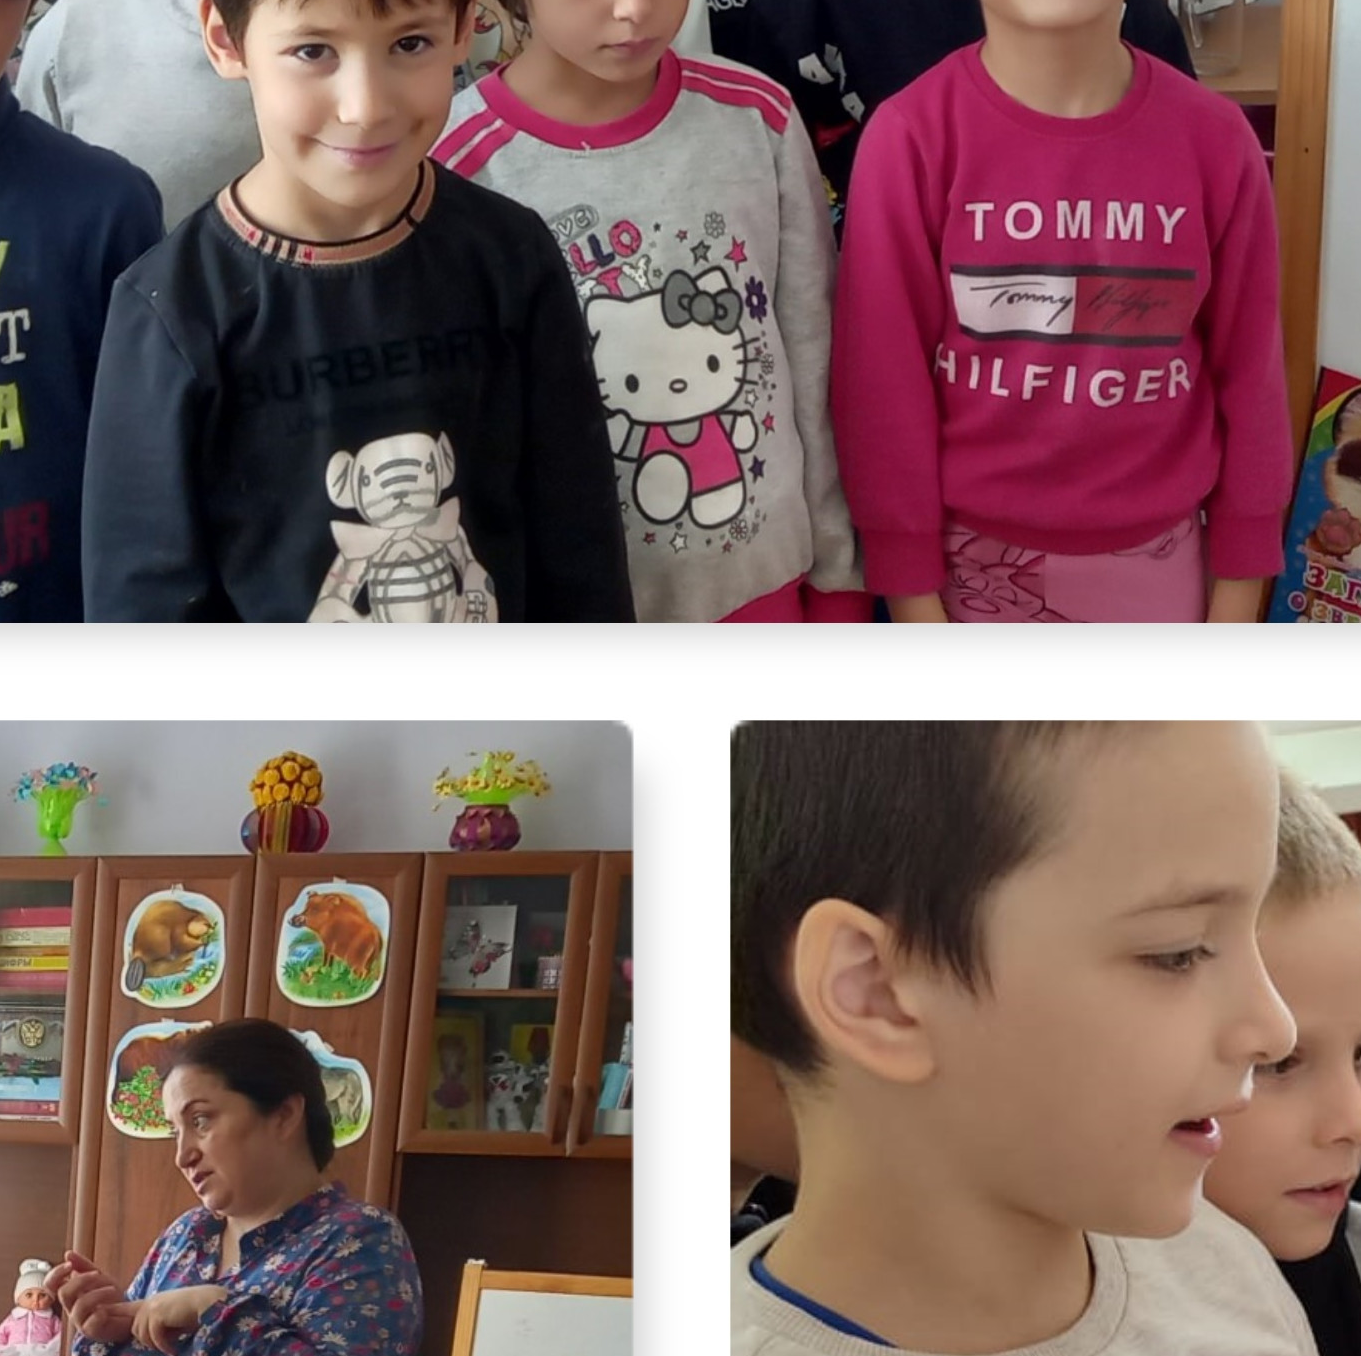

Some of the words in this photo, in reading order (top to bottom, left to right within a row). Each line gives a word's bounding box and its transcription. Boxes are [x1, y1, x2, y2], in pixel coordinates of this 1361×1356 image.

[568, 219, 642, 277] LLO
[965, 200, 1187, 244] TOMMY
[970, 282, 1073, 327] Tommy
[239, 327, 484, 413] BURBERR
[935, 343, 1191, 407] HILFIGER
